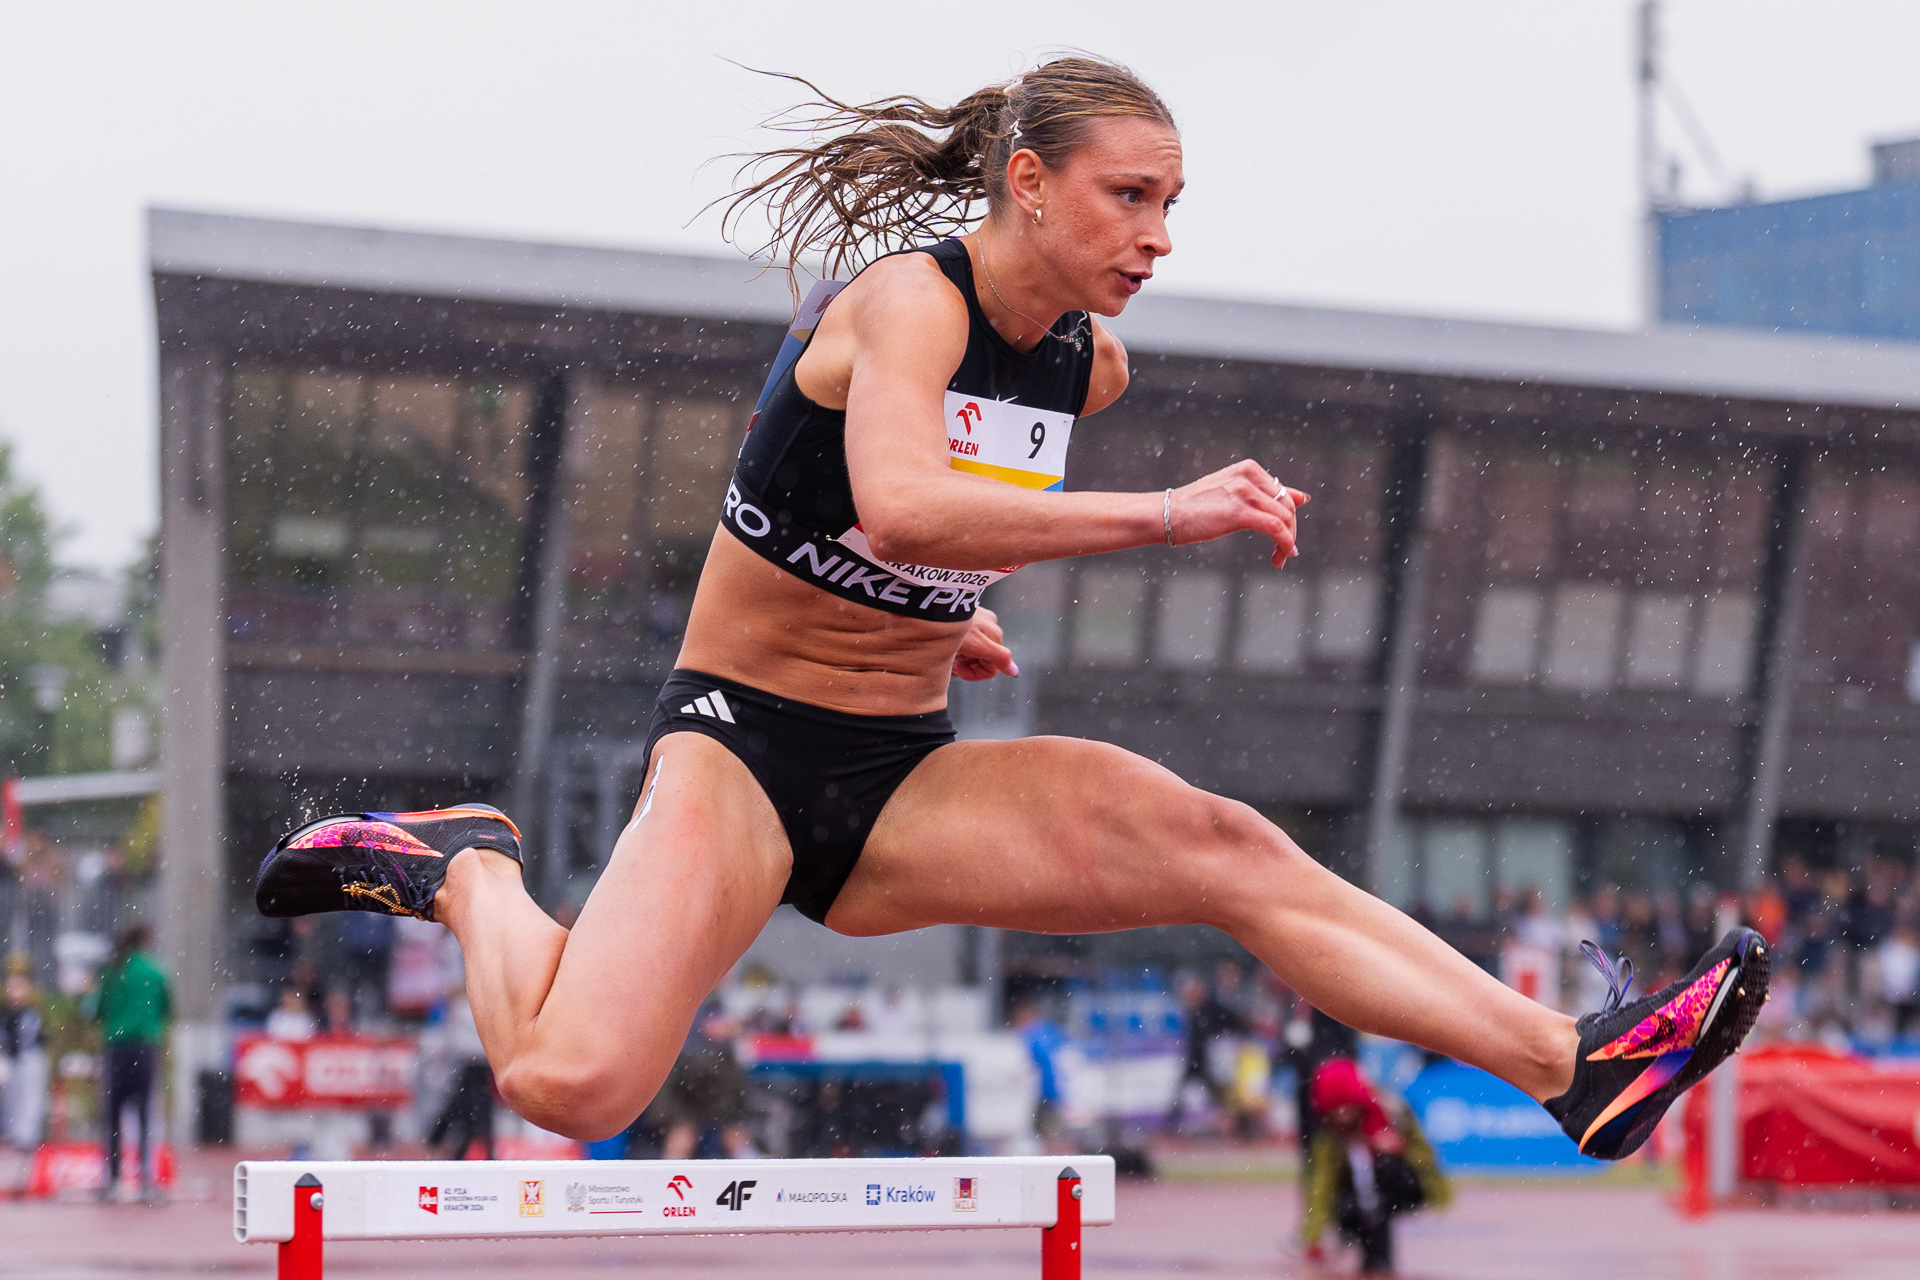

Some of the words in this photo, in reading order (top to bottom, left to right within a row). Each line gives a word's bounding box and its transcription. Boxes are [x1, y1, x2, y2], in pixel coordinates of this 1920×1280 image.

[1028, 421, 1045, 459] 9
[723, 476, 771, 538] RO
[786, 541, 918, 606] NIKE
[952, 572, 989, 586] 2026
[588, 1184, 631, 1193] Ministerstwo
[716, 1180, 757, 1211] 4F
[789, 1192, 848, 1203] MAŁOPOLSKA
[886, 1185, 936, 1203] Kraków
[663, 1206, 696, 1218] ORLEN
